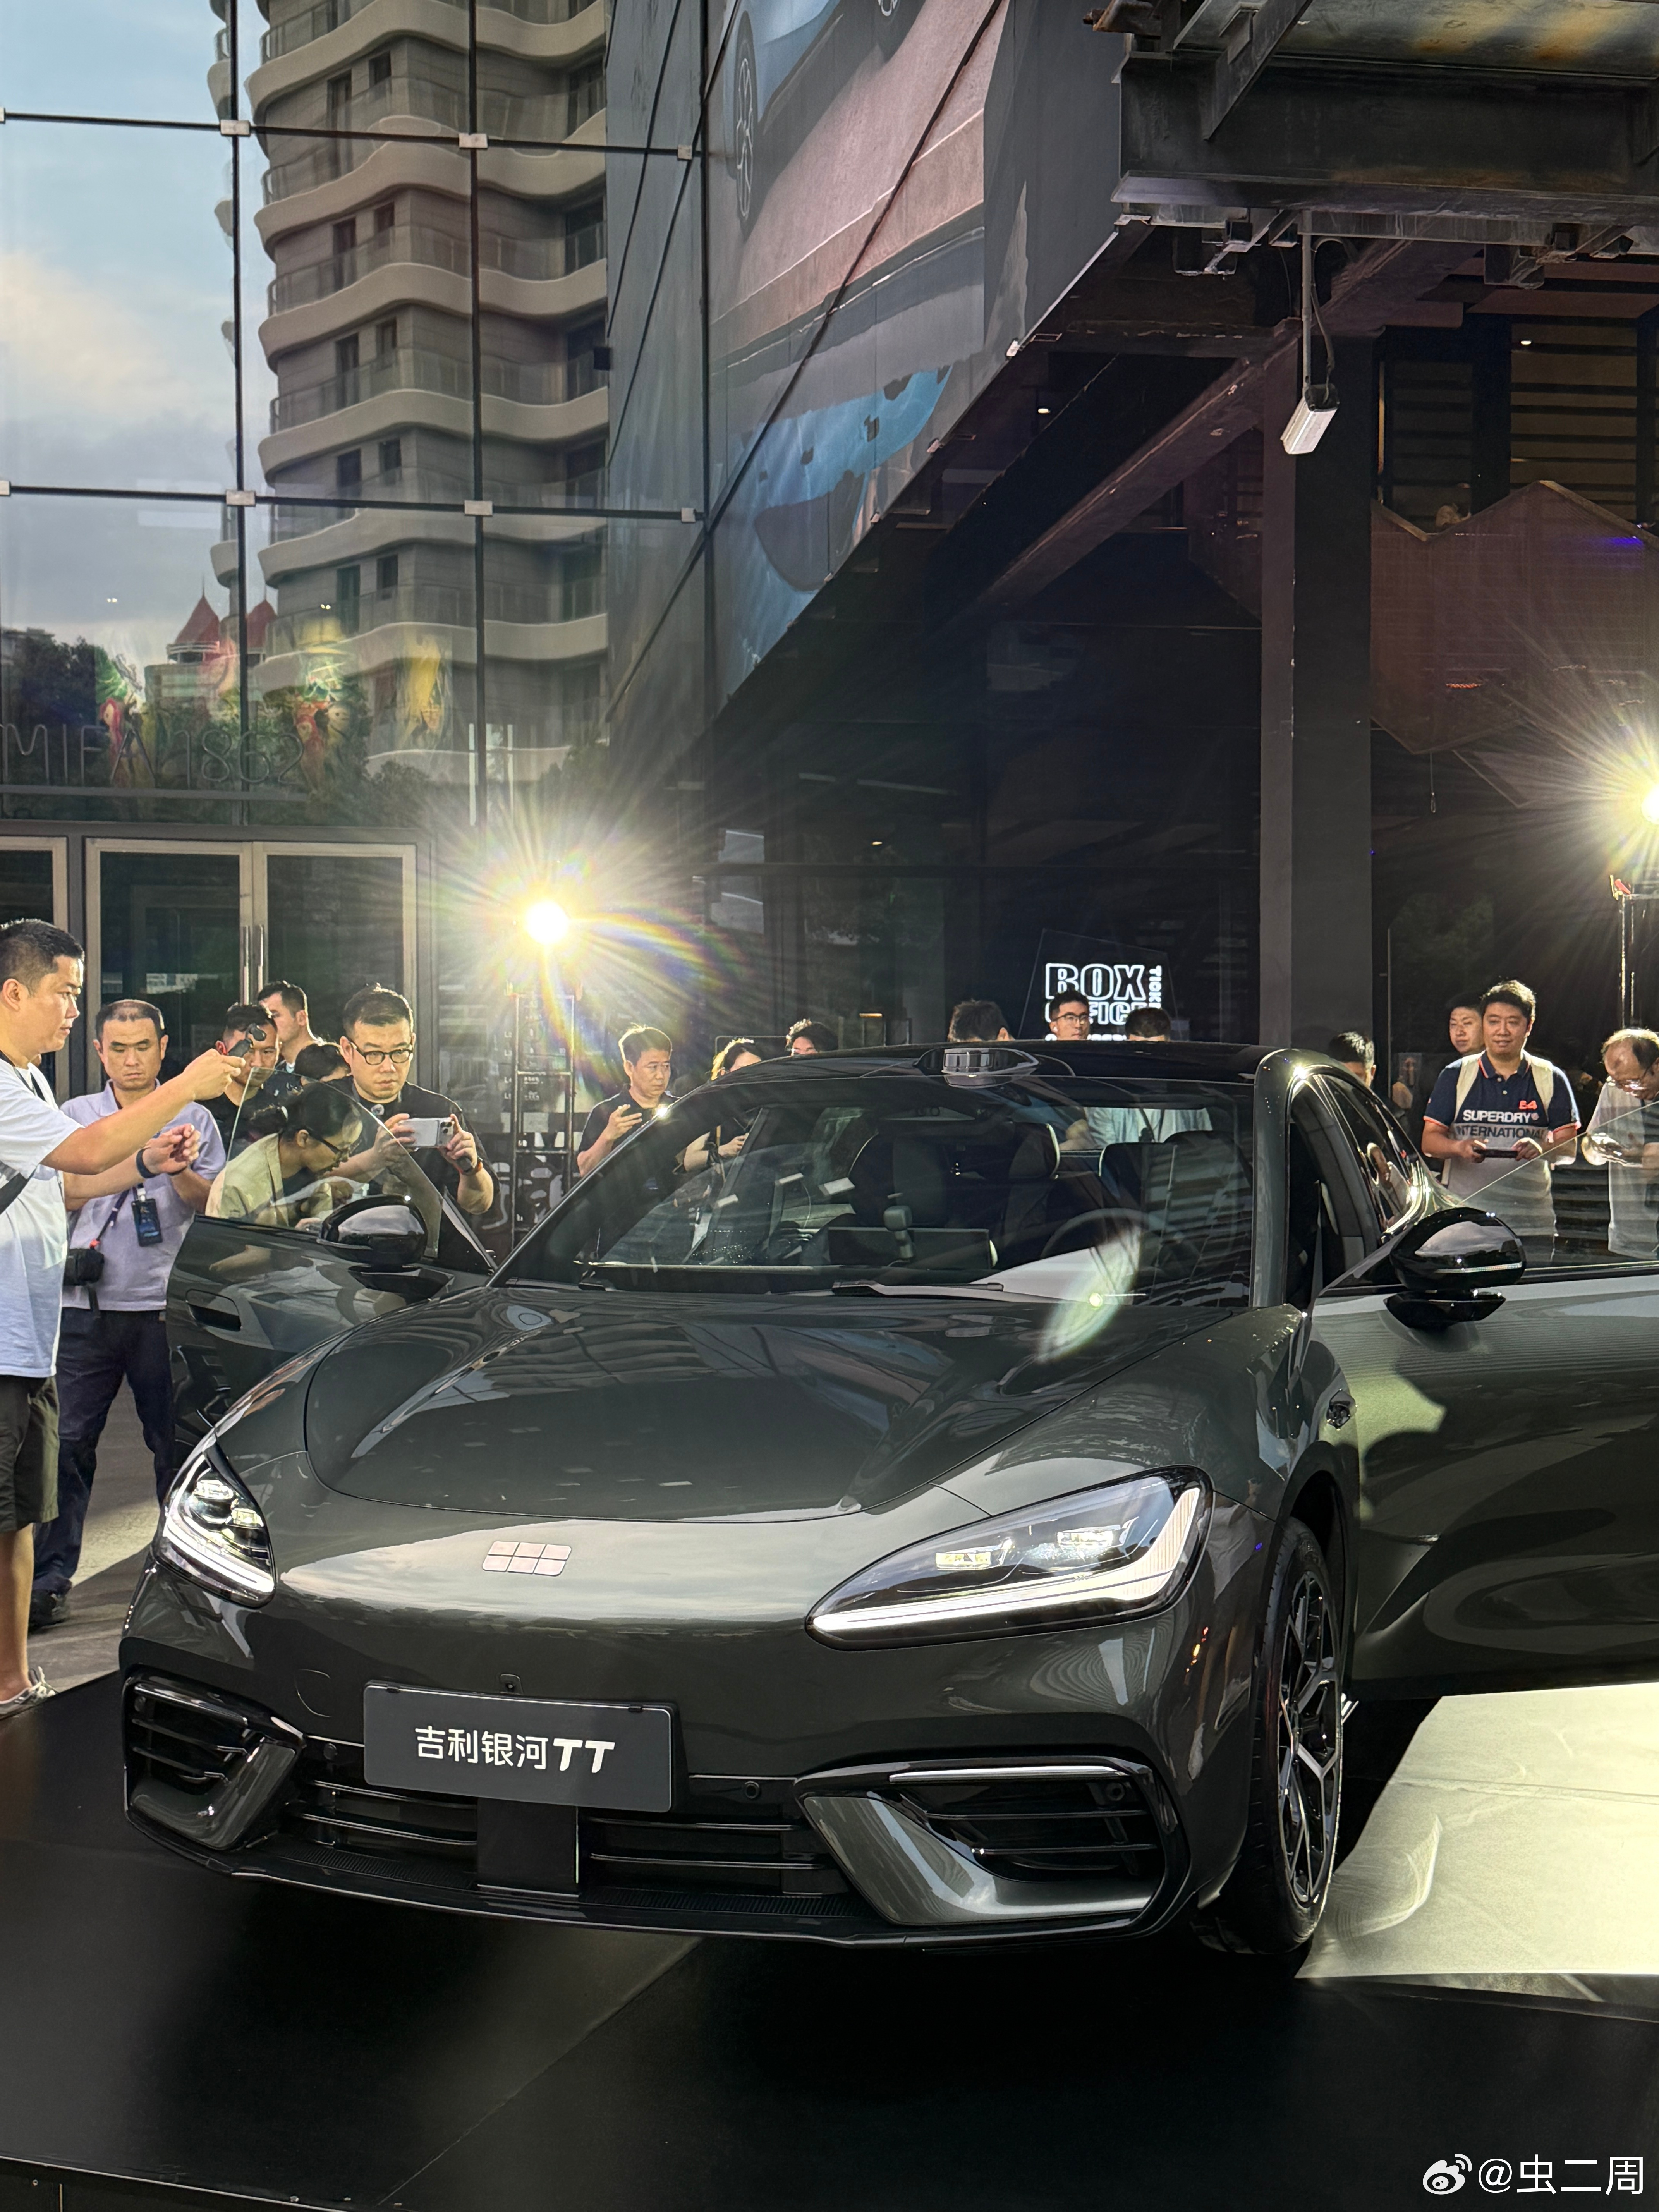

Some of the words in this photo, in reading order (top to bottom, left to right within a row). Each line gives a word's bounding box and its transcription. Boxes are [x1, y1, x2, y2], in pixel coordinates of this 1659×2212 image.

[174, 729, 304, 788] 1862
[1045, 963, 1146, 1001] BOX
[1463, 1109, 1531, 1123] SUPERDRY
[415, 1725, 615, 1774] 吉利银河TT
